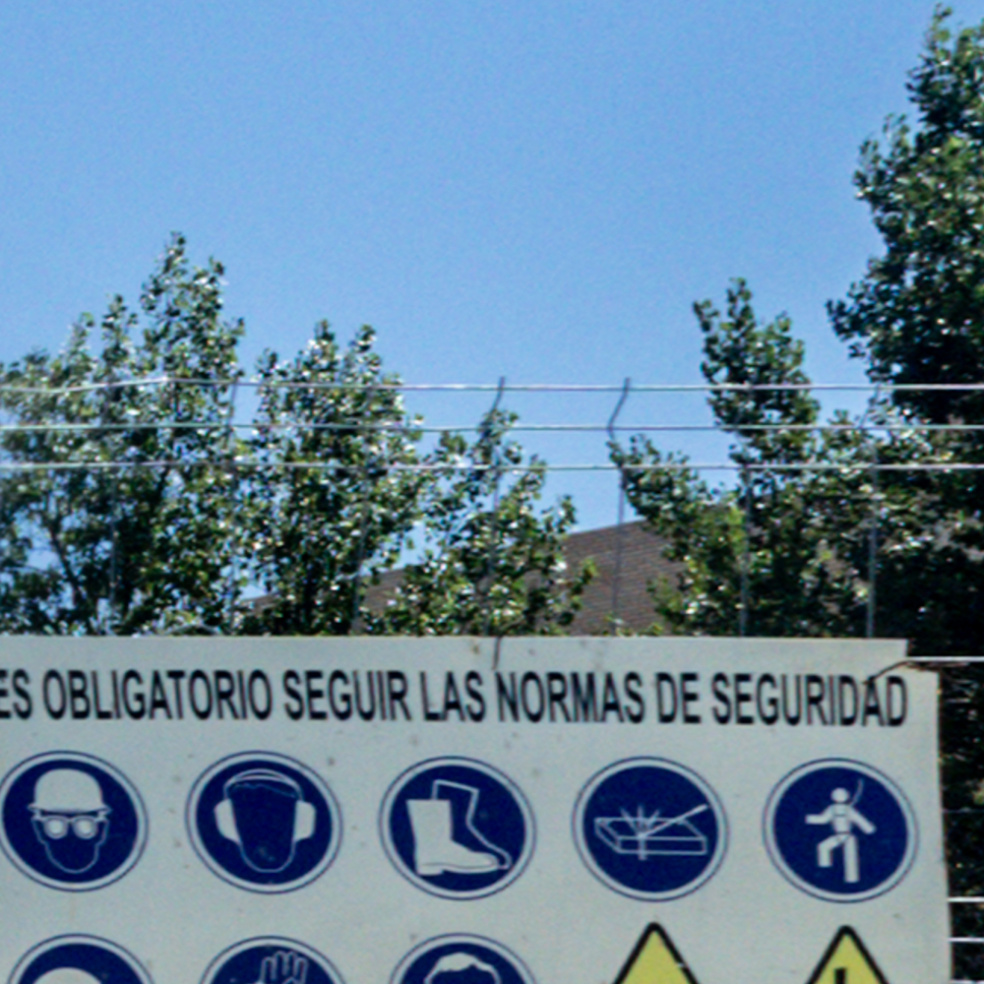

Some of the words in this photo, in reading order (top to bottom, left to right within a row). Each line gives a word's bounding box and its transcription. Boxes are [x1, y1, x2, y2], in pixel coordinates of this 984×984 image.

[42, 669, 273, 720] OBLIGATORIO
[283, 669, 412, 721] SEGUIR
[419, 670, 486, 722] LAS
[494, 670, 646, 723] NORMAS
[656, 671, 702, 724] DE
[711, 673, 908, 726] SEGURIDAD
